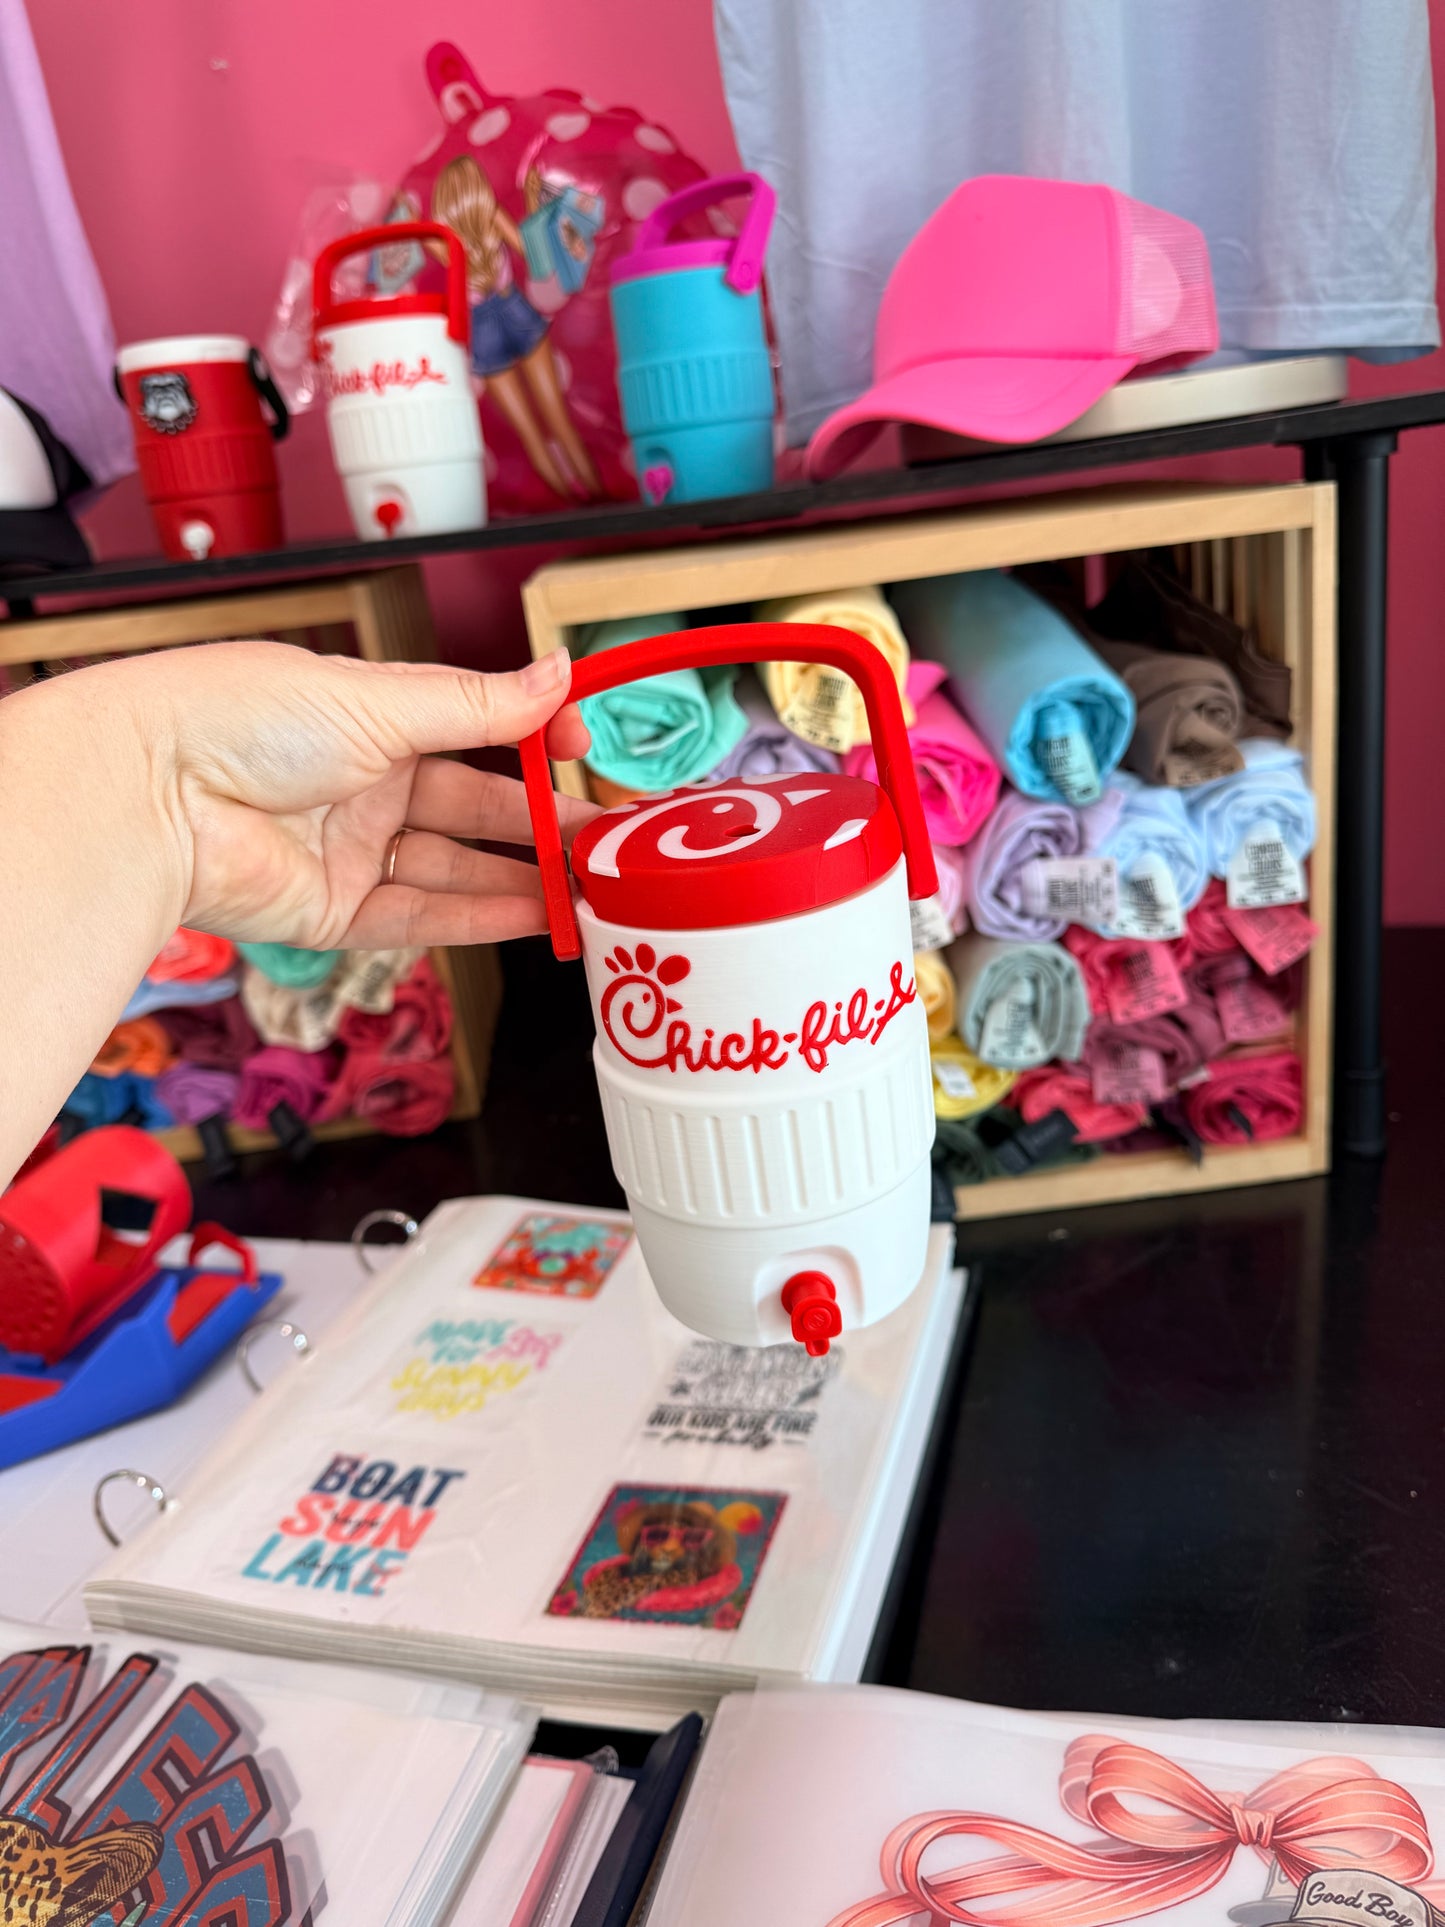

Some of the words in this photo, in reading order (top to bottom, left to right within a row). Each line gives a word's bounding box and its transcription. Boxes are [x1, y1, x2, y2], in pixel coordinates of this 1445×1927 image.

[310, 1452, 466, 1508] BOAT
[278, 1493, 437, 1552] SUN
[241, 1534, 409, 1597] LAKE
[1306, 1881, 1363, 1906] Good
